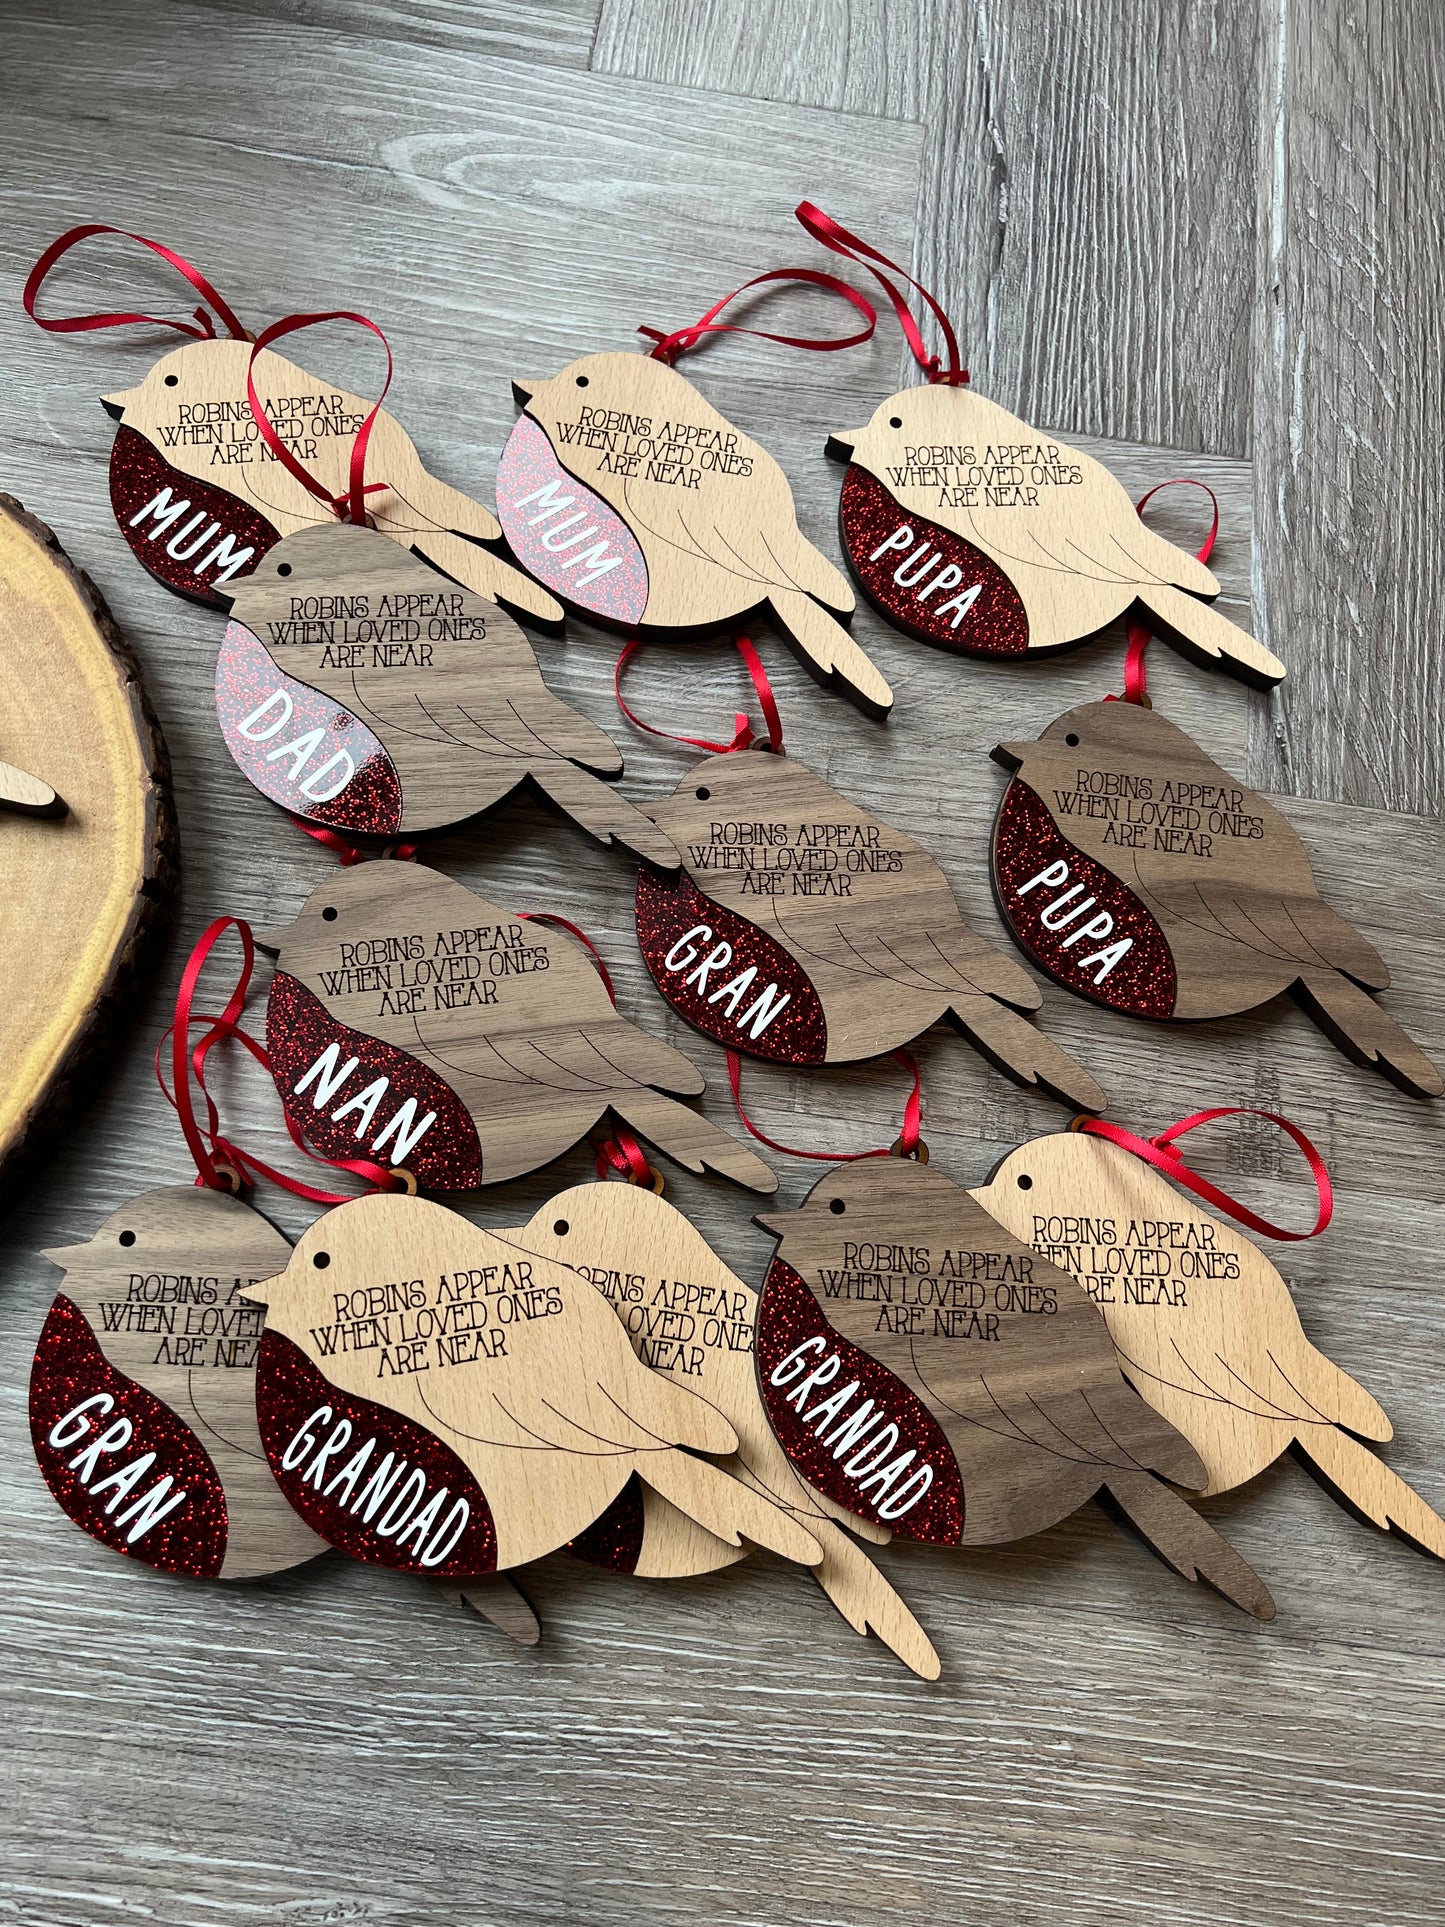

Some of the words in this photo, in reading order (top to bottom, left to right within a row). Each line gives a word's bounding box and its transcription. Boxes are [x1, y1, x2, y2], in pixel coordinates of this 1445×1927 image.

[178, 401, 253, 424] ROBINS
[263, 394, 345, 418] APPEAR
[157, 424, 224, 447] WHEN
[231, 419, 304, 442] LOED
[311, 414, 365, 437] ONES
[578, 406, 652, 437] ROBINS
[657, 421, 738, 453] APPEAR
[209, 443, 253, 465] ARE
[556, 422, 618, 452] WHEN
[623, 435, 694, 466] LOVED
[700, 450, 754, 478] ONES
[904, 446, 976, 466] ROBINS
[983, 445, 1062, 465] APPEAR
[596, 452, 639, 478] ARE
[644, 461, 702, 489] NEAR
[886, 466, 948, 487] WHEN
[957, 466, 1027, 486] LOVED
[1031, 466, 1083, 485] ONES
[938, 488, 978, 508] ARE
[985, 487, 1039, 506] NEAR
[129, 487, 255, 584] MUM
[514, 479, 623, 588] MUM
[869, 525, 983, 629] PUPA
[289, 596, 369, 621] ROBINS
[376, 594, 465, 618] APPEAR
[266, 621, 335, 645] WHEN
[343, 620, 421, 643] LOVED
[428, 618, 486, 641] ONES
[319, 646, 365, 669] ARE
[372, 644, 434, 668] NEAR
[238, 688, 356, 802] DAD
[1076, 769, 1153, 799] ROBINS
[1159, 781, 1244, 813] APPEAR
[1053, 790, 1119, 821] WHEN
[1126, 801, 1201, 831] LOVED
[1208, 811, 1264, 839] ONES
[709, 822, 788, 846] ROBINS
[795, 824, 881, 848] APPEAR
[1101, 822, 1147, 849] ARE
[1153, 829, 1212, 858] NEAR
[687, 846, 755, 869] WHEN
[762, 849, 838, 871] LOVED
[845, 850, 903, 872] ONES
[739, 872, 785, 895] ARE
[792, 873, 852, 897] NEAR
[1017, 859, 1133, 985] PUPA
[340, 935, 424, 968] ROBINS
[432, 924, 526, 957] APPEAR
[318, 966, 393, 996] WHEN
[399, 956, 482, 988] LOVED
[489, 947, 550, 976] ONES
[664, 924, 791, 1040] GRAN
[378, 989, 427, 1017] ARE
[434, 980, 499, 1010] NEAR
[294, 1042, 437, 1166] NAN
[1032, 1216, 1117, 1245] ROBINS
[1125, 1220, 1216, 1251] APPEAR
[843, 1242, 930, 1275] ROBINS
[938, 1250, 1034, 1284] APPEAR
[1025, 1244, 1083, 1273] HEN
[1091, 1247, 1172, 1276] LOVED
[1180, 1251, 1241, 1279] ONES
[126, 1274, 219, 1305] ROBINS
[332, 1280, 426, 1322] ROBINS
[435, 1261, 535, 1304] APPEAR
[651, 1280, 747, 1321] APPEAR
[818, 1269, 893, 1302] WHEN
[901, 1277, 986, 1309] LOVED
[994, 1284, 1058, 1315] ONES
[1072, 1275, 1116, 1303] RE
[1123, 1277, 1188, 1307] NEAR
[99, 1303, 177, 1333] WHEN
[309, 1317, 392, 1356] WHEN
[399, 1301, 489, 1342] LOVED
[497, 1287, 564, 1324] ONES
[703, 1319, 754, 1352] ONE
[875, 1306, 926, 1335] ARE
[932, 1311, 1000, 1341] NEAR
[152, 1338, 208, 1366] ARE
[376, 1342, 429, 1378] ARE
[438, 1329, 508, 1368] NEAR
[640, 1339, 705, 1376] NEAR
[770, 1336, 934, 1520] GRANDAD
[49, 1392, 186, 1544] GRAN
[281, 1405, 470, 1568] GRANDAD
